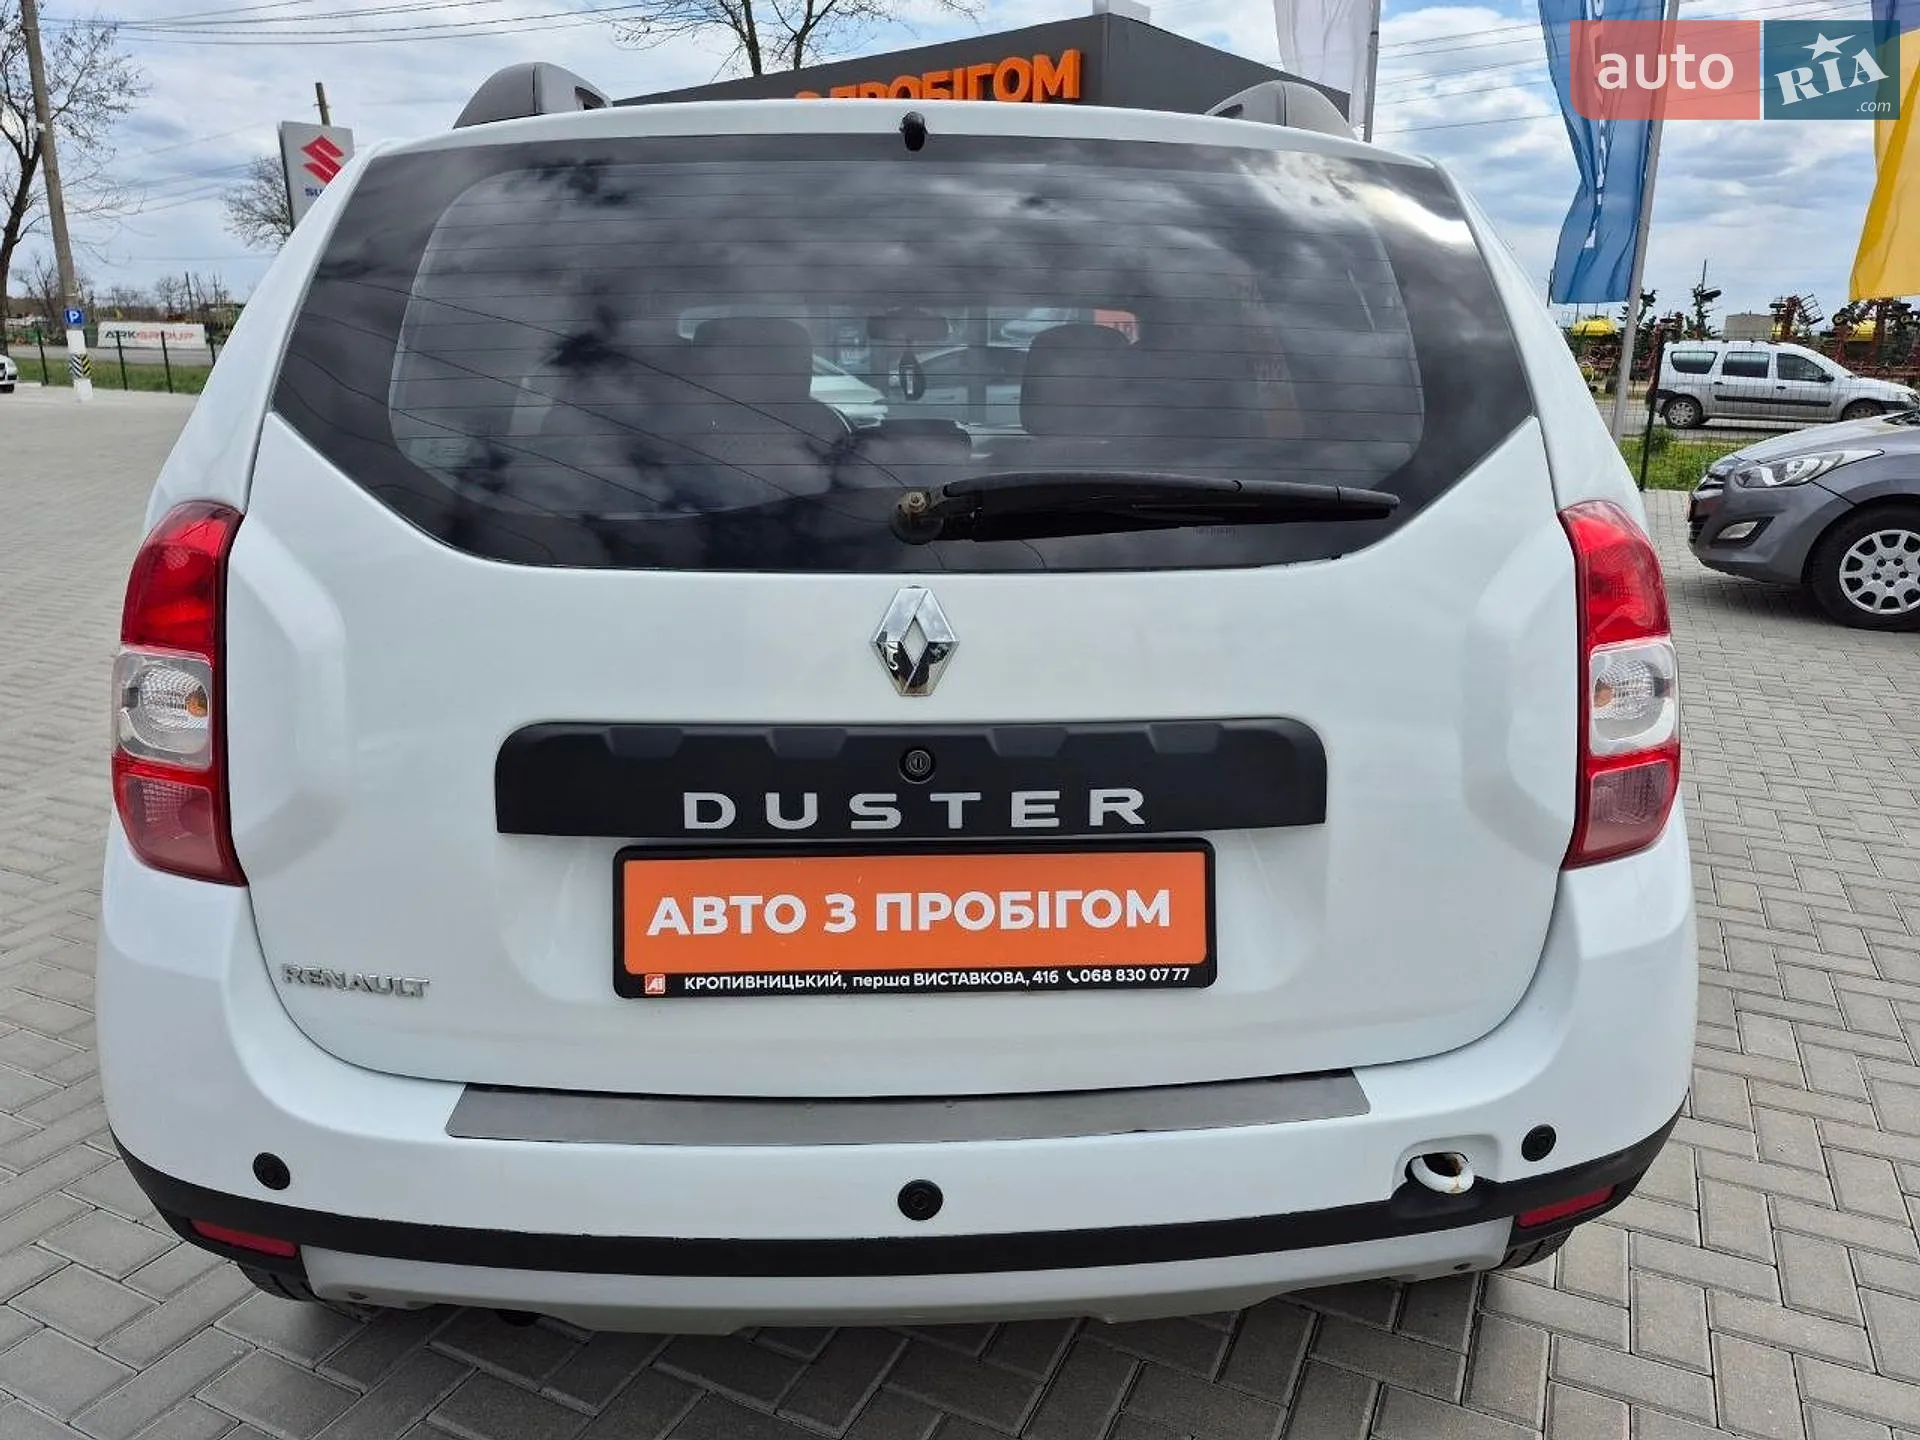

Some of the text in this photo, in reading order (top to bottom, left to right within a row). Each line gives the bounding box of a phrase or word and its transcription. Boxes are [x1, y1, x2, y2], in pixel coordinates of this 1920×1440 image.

[684, 788, 1146, 830] DUSTER
[646, 889, 1171, 936] АВТО З ПРОБІГОМ
[281, 962, 431, 998] RENAULT
[684, 971, 848, 992] КРОПИВНИЦЬКИЙ,
[852, 974, 910, 990] перша
[913, 971, 1030, 987] ВИСТАВКОВА,
[1032, 969, 1059, 984] 416
[1080, 969, 1111, 983] 068
[1115, 969, 1146, 982] 830
